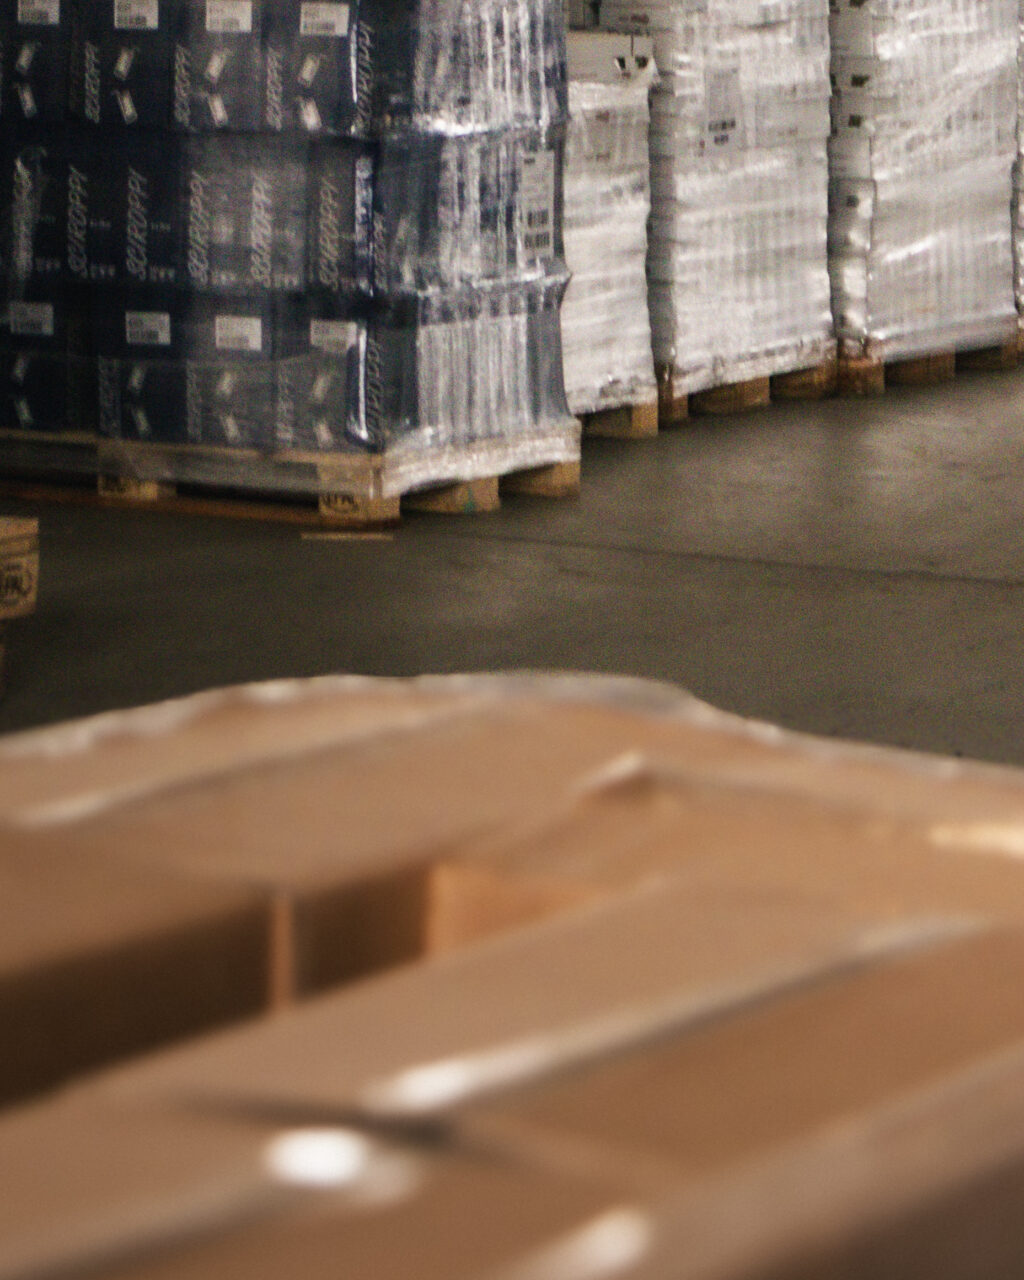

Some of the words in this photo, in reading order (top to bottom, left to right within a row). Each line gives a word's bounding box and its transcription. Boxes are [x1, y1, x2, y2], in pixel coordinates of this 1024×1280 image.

[67, 164, 89, 279] SCIROPPI
[126, 166, 149, 281] SCIROPPI
[187, 169, 210, 286] SCIROPPI
[318, 176, 339, 292] SCIROPPI
